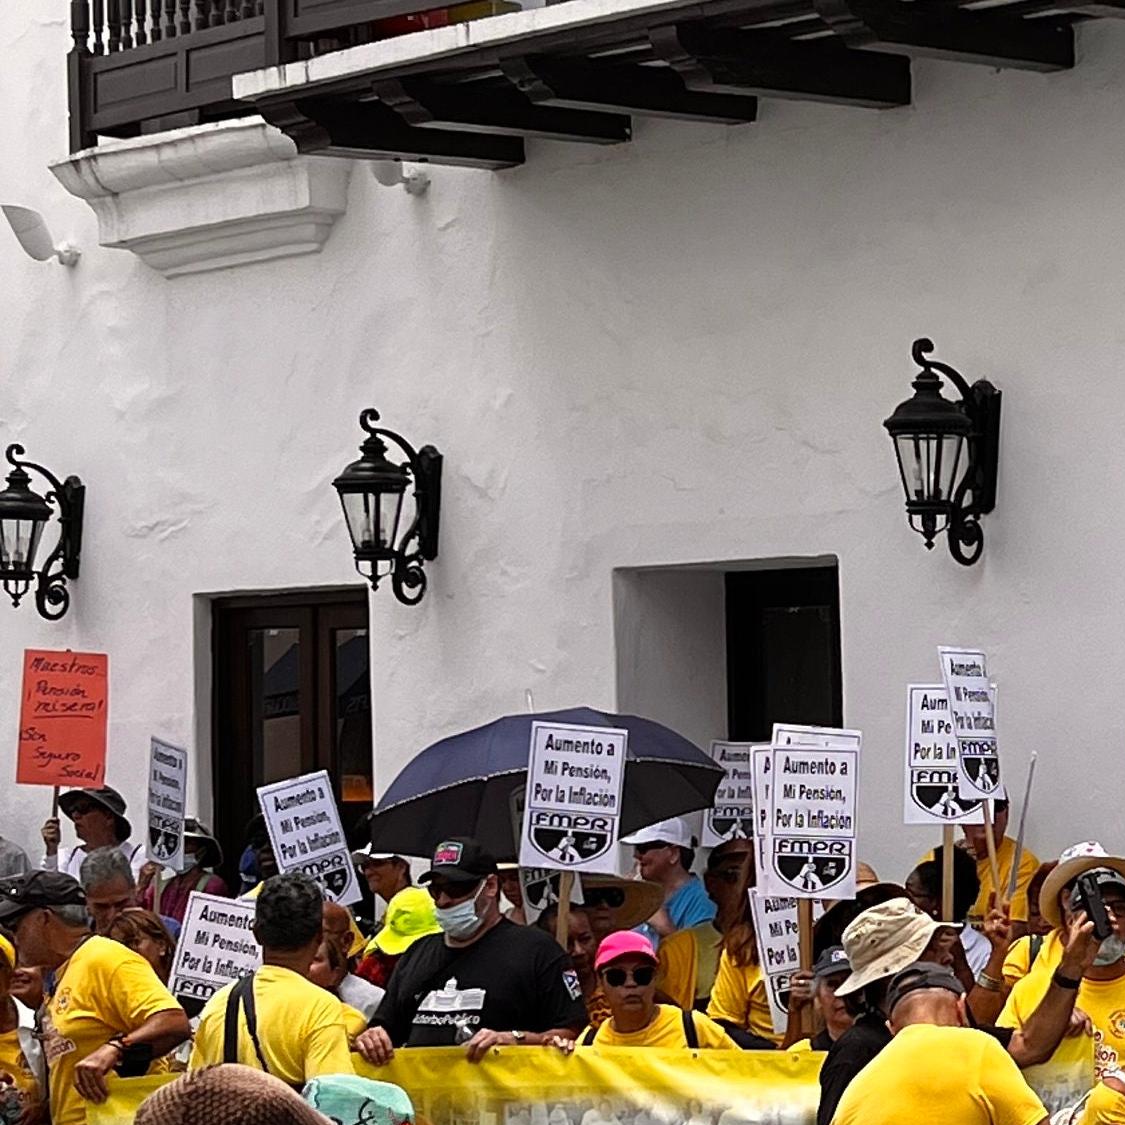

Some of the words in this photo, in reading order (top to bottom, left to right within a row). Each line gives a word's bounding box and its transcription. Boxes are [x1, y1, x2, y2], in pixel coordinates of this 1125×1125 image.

[30, 656, 98, 675] Maestros
[921, 720, 935, 734] Mi
[545, 734, 603, 756] Aumento
[607, 743, 615, 757] a
[914, 743, 931, 760] Por
[933, 743, 943, 760] la
[544, 760, 558, 776] Mi
[561, 762, 611, 783] Pensión,
[783, 755, 836, 775] Aumento
[840, 761, 848, 775] a
[274, 787, 317, 812] Aumento
[534, 783, 551, 802] Por
[555, 785, 565, 803] la
[783, 783, 796, 799] Mi
[799, 783, 846, 804] Pensión,
[535, 812, 608, 831] FMPR
[776, 808, 792, 828] Por
[795, 808, 804, 828] la
[778, 840, 846, 855] FMPR
[765, 897, 797, 914] Aume
[194, 930, 209, 946] Mi
[181, 951, 201, 971] Por
[202, 954, 212, 974] la
[767, 947, 785, 966] Por
[787, 945, 797, 962] la
